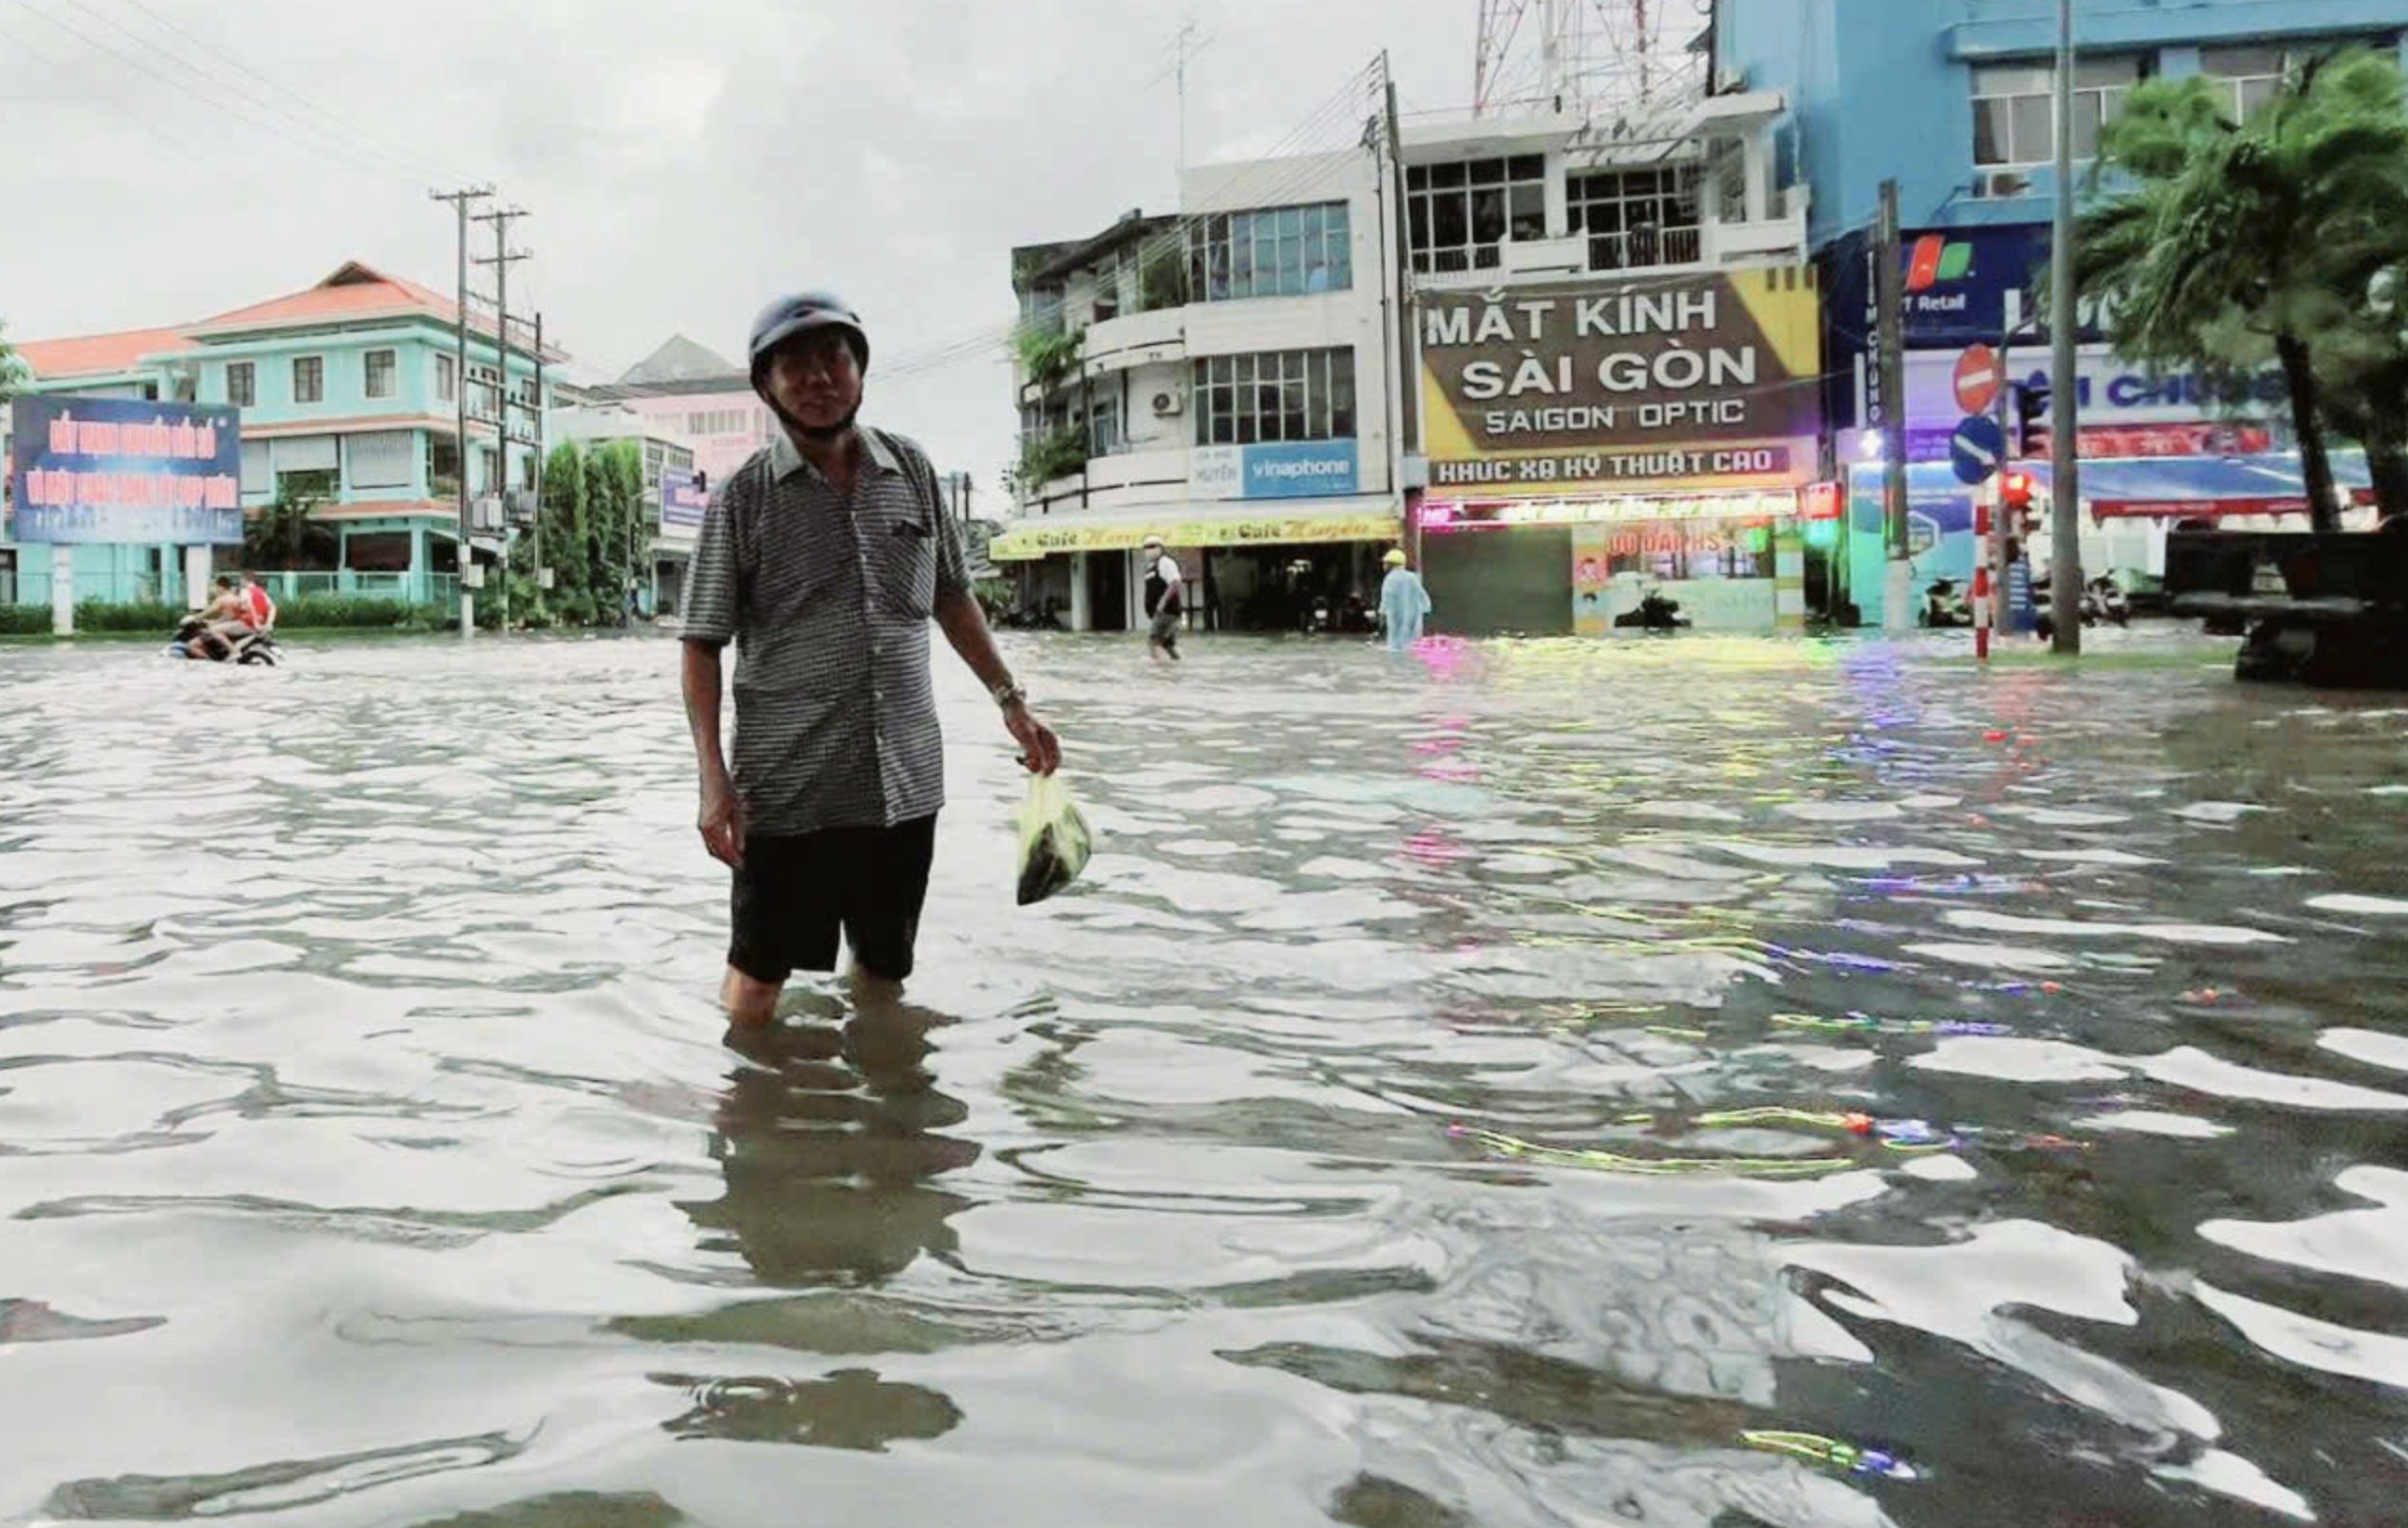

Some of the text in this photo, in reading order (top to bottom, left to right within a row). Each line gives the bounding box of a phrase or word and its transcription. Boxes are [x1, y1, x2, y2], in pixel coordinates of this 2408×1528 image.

[1427, 285, 1715, 345] MẮT KÍNH
[1462, 338, 1755, 400] SÀI GÒN
[1486, 399, 1745, 434] SAIGON OPTIC
[1251, 457, 1351, 478] vinaphone
[1713, 449, 1773, 473] CAO
